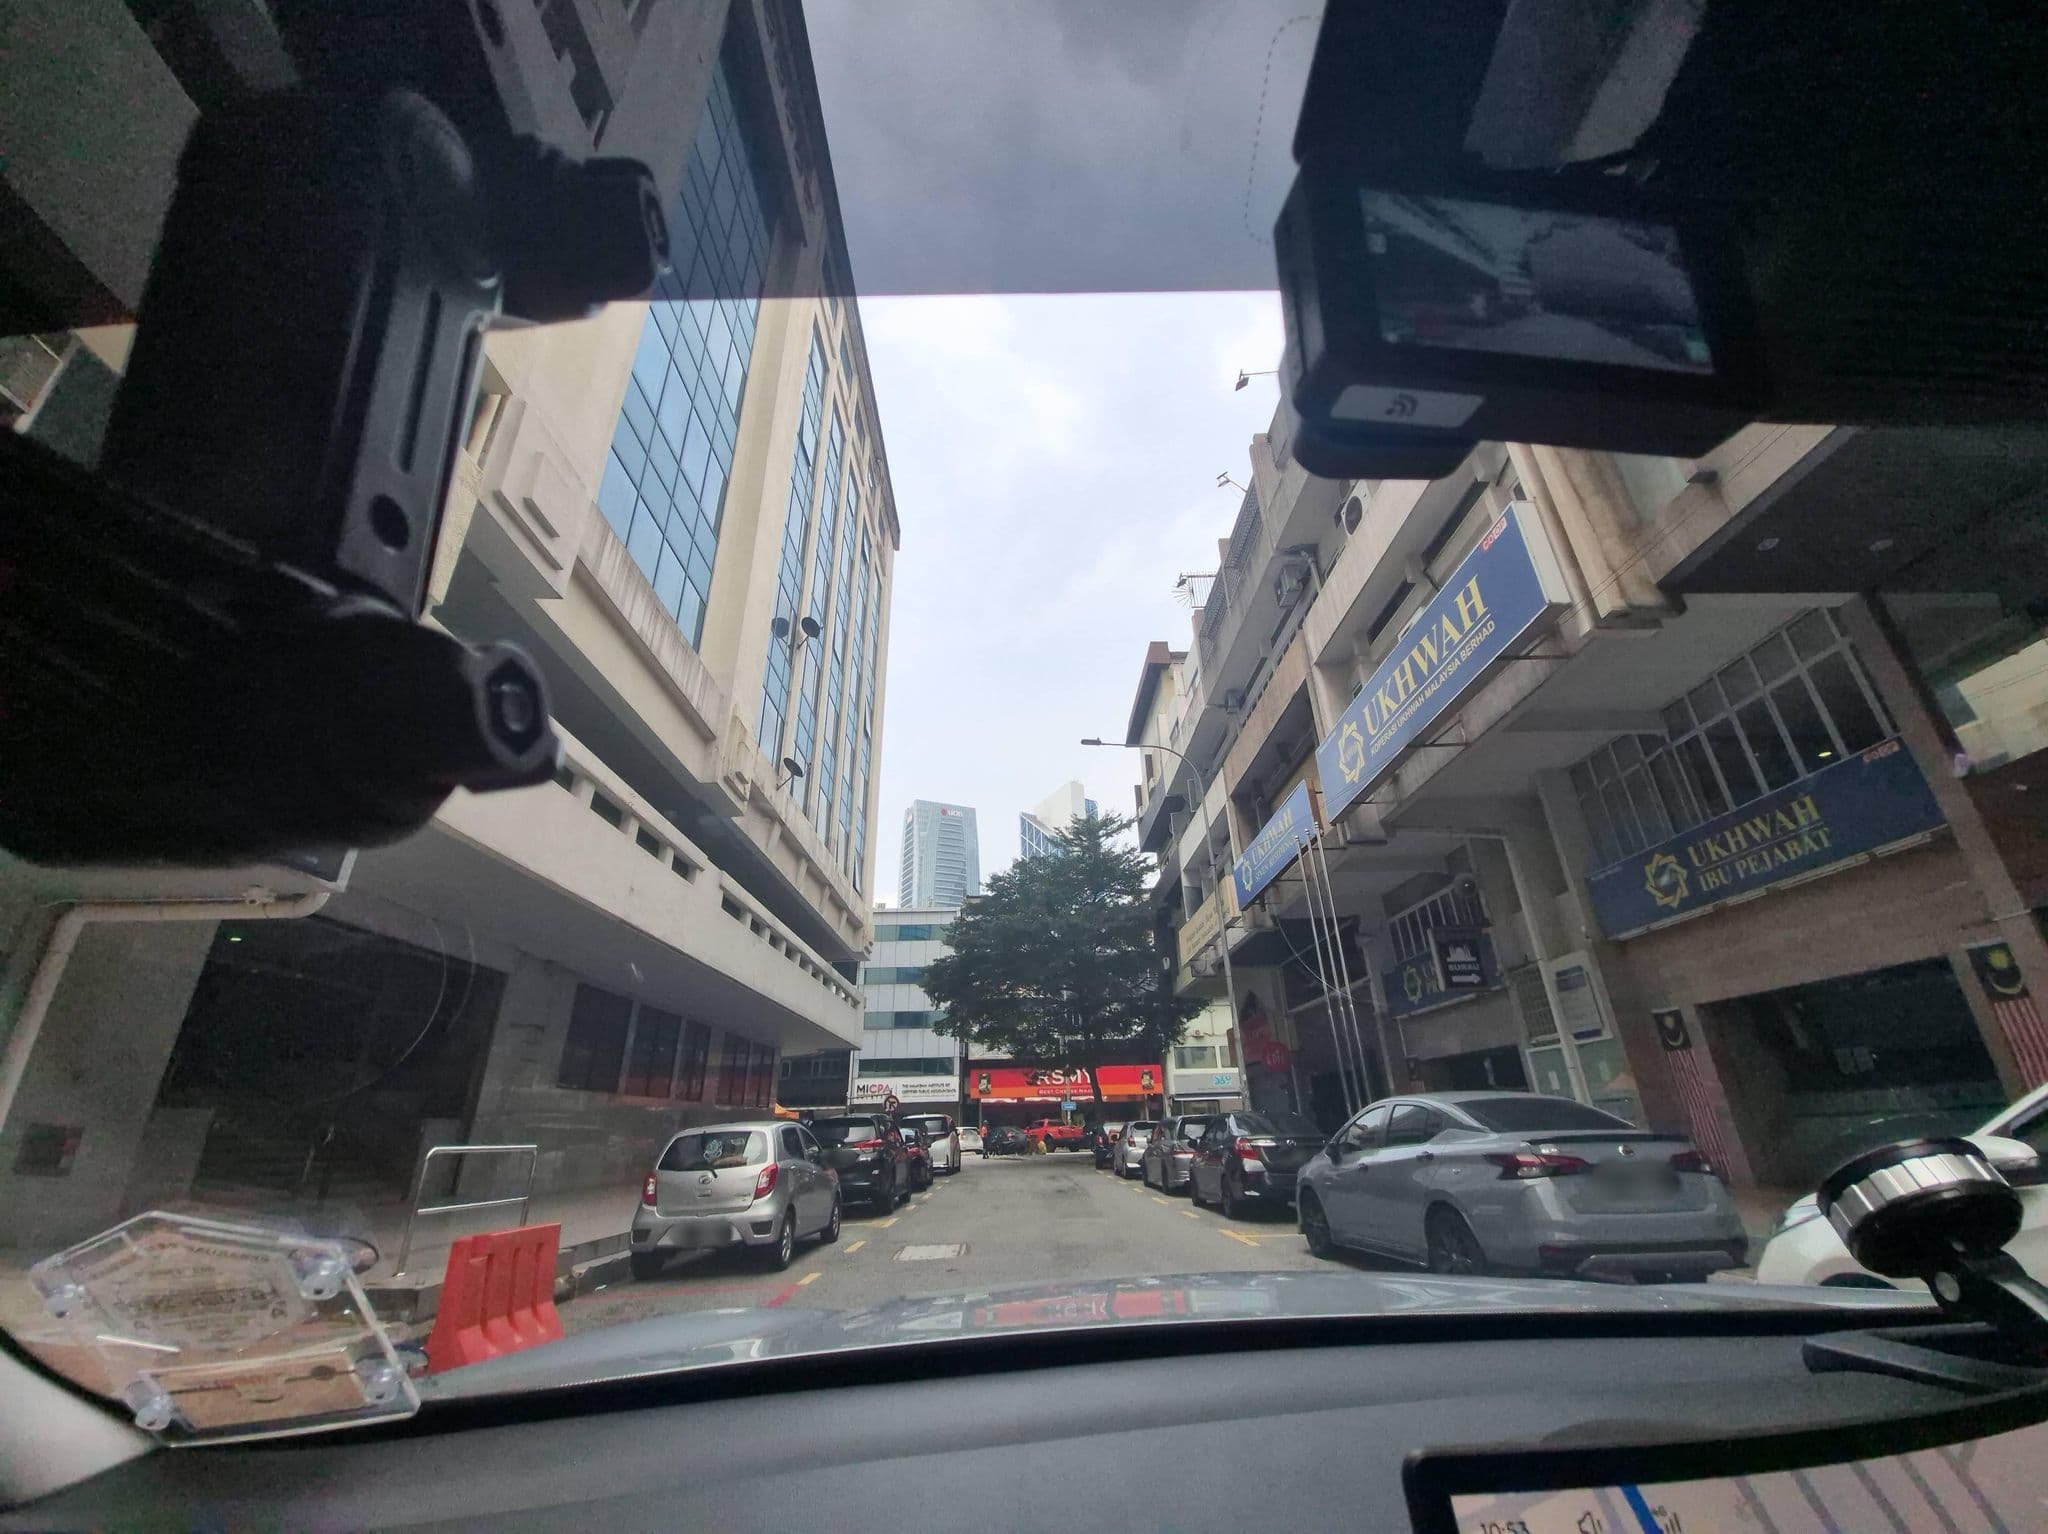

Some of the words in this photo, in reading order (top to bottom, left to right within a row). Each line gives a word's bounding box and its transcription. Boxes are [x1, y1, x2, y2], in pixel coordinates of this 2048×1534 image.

[1362, 574, 1490, 736] UKHWAH
[1371, 721, 1399, 757] KOPERASI
[1397, 695, 1426, 732] UKHWAH
[1424, 656, 1462, 701] MALAYSIA
[1459, 619, 1496, 662] BERHAD
[1251, 807, 1294, 866] UKHWAH
[1687, 794, 1822, 868] UKHWAH
[1698, 865, 1733, 892] IBU
[1735, 826, 1834, 880] PEJABAT
[856, 1083, 891, 1094] MICPA
